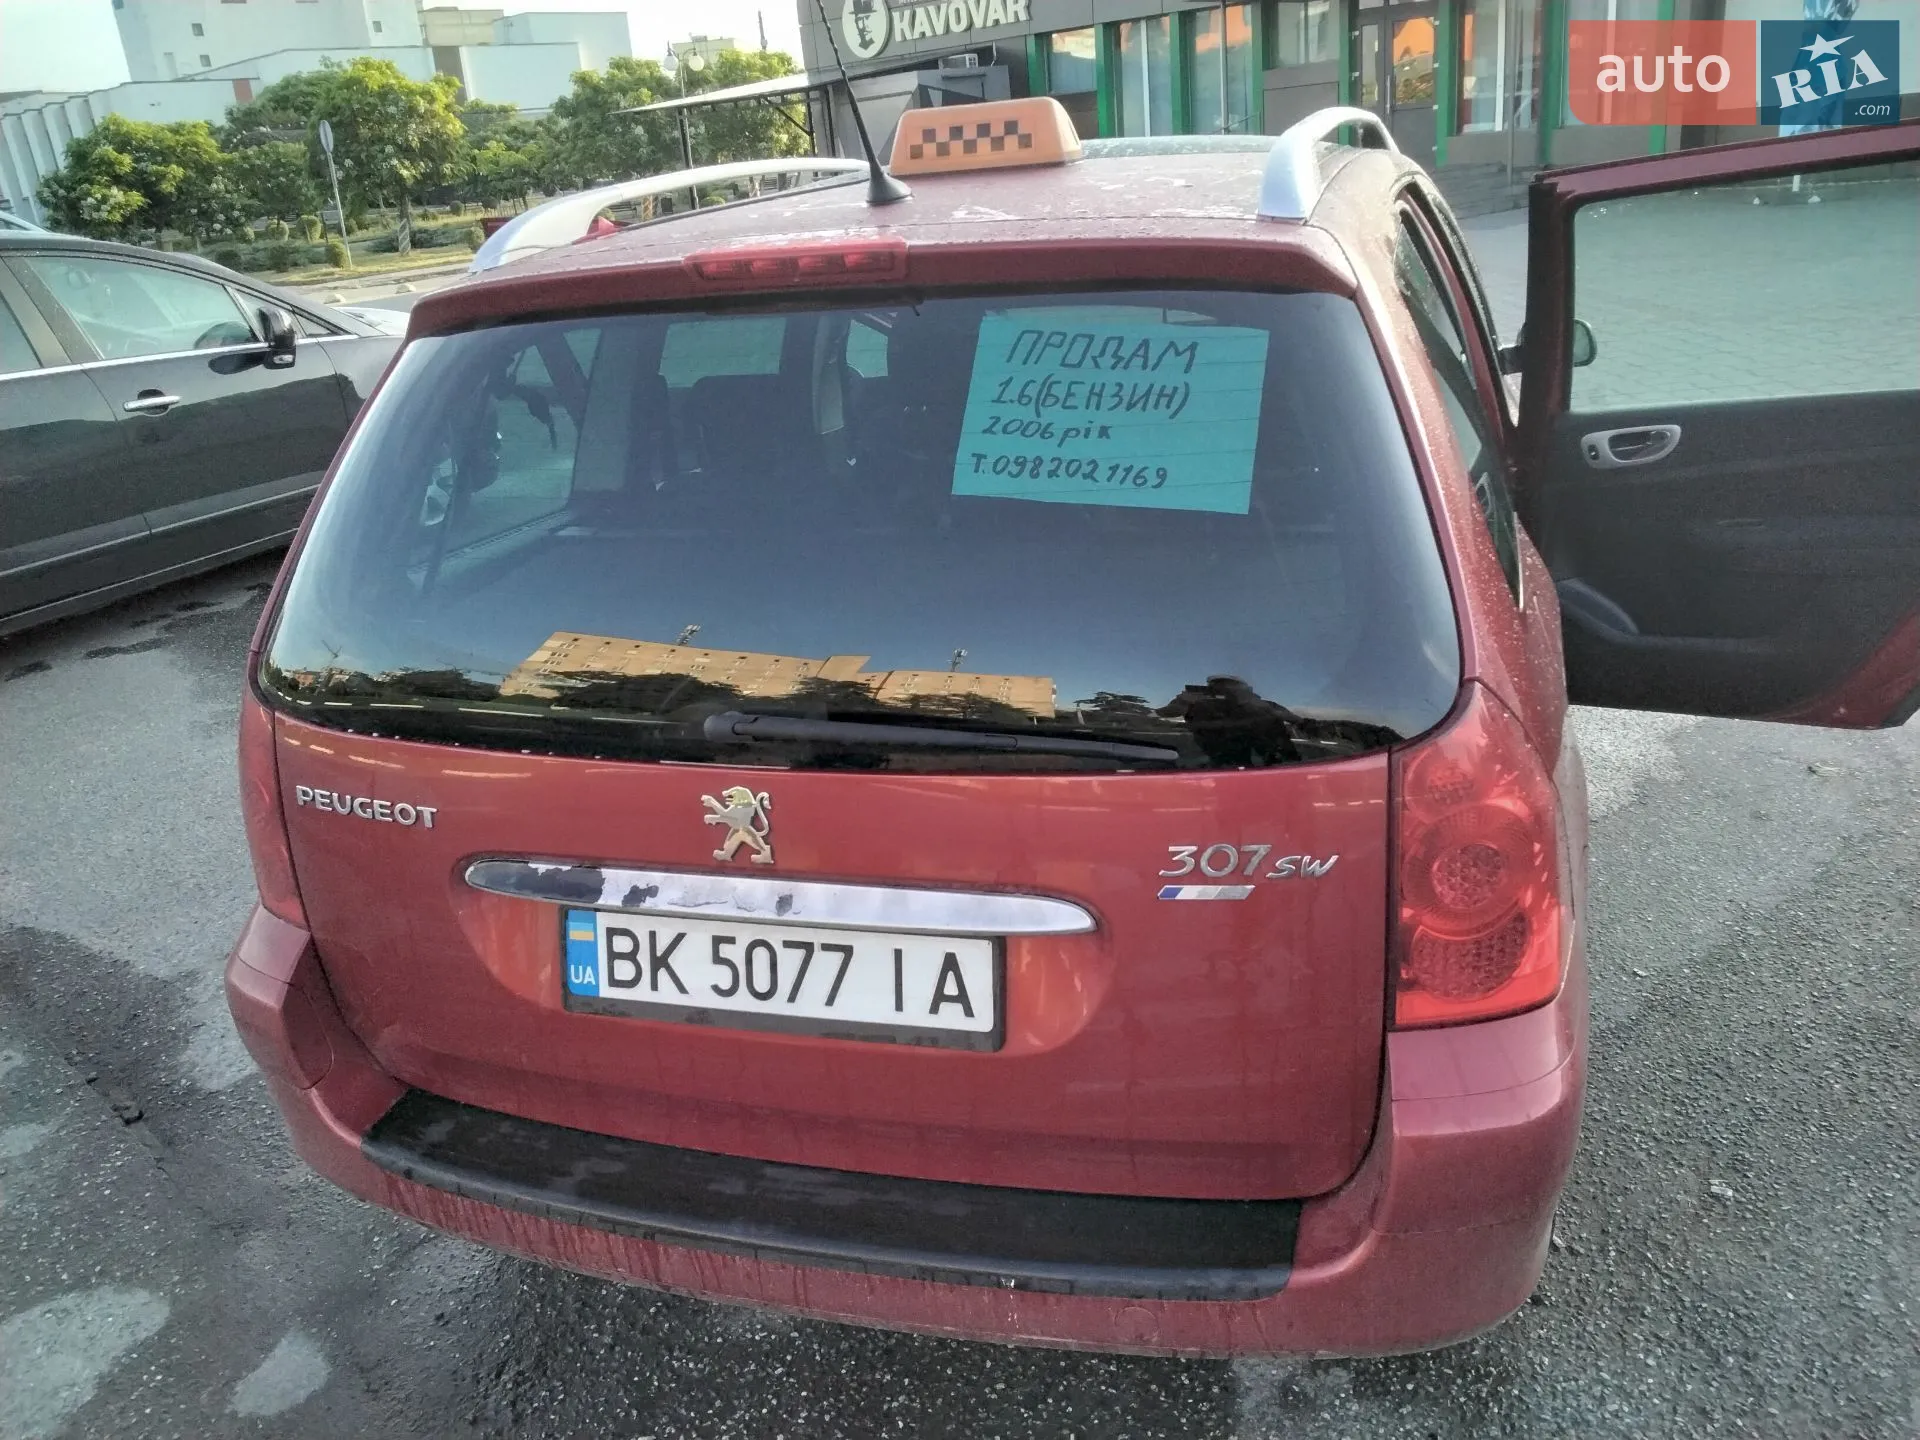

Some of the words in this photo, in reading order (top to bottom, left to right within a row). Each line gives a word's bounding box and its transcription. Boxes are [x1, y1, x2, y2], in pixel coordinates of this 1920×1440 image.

[892, 0, 1029, 42] KAVOVAR
[1005, 329, 1199, 374] ПРОДАМ
[295, 784, 438, 829] PEUGEOT
[1158, 843, 1273, 878] 307
[570, 965, 596, 986] UA
[605, 926, 690, 995] BK
[710, 934, 854, 1007] 5077
